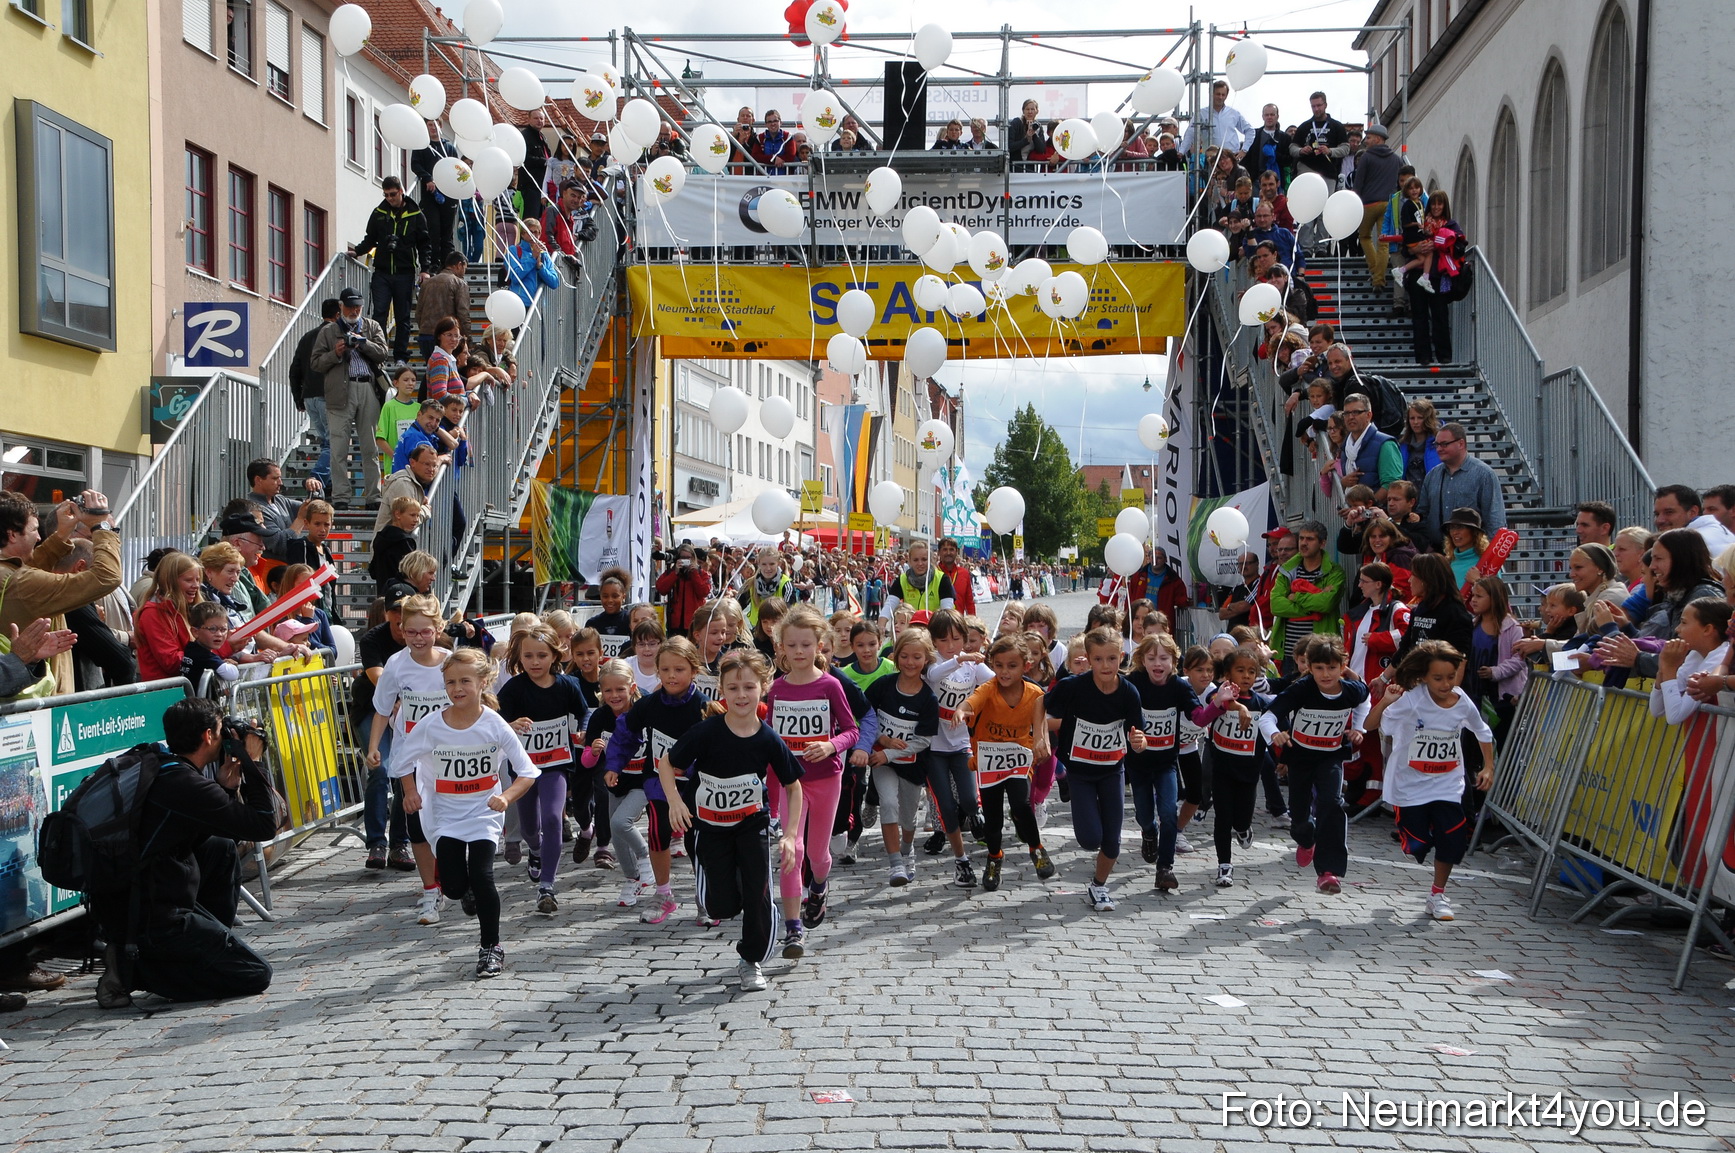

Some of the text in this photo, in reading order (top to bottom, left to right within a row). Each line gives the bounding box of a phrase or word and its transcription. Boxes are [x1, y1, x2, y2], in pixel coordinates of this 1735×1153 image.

[953, 215, 992, 228] Mehr
[997, 214, 1084, 228] Fahrfreude.
[657, 302, 775, 315] Neumarkter Stadtlauf
[1101, 303, 1153, 314] Stadtlauf
[1165, 383, 1184, 581] VARIOTE
[938, 688, 971, 709] 702
[1298, 711, 1317, 719] PARTL
[78, 713, 146, 741] Event-Leit-Systeme
[536, 723, 561, 732] Neumarkt
[775, 714, 823, 736] 7209
[889, 721, 914, 731] Neumarkt
[1217, 717, 1254, 741] 7156
[1301, 719, 1343, 738] 7172
[522, 729, 562, 751] 7021
[996, 745, 1023, 753] Neumarkt
[1080, 730, 1122, 750] 7024
[433, 748, 488, 757] PARTL Neumarkt
[1415, 741, 1457, 760] 7034
[440, 755, 492, 779] 7036
[983, 753, 1028, 771] 7250
[454, 782, 480, 793] Mona
[700, 777, 751, 790] PARTL Neumarkt
[704, 787, 755, 810] 7022
[713, 811, 747, 821] Tamina
